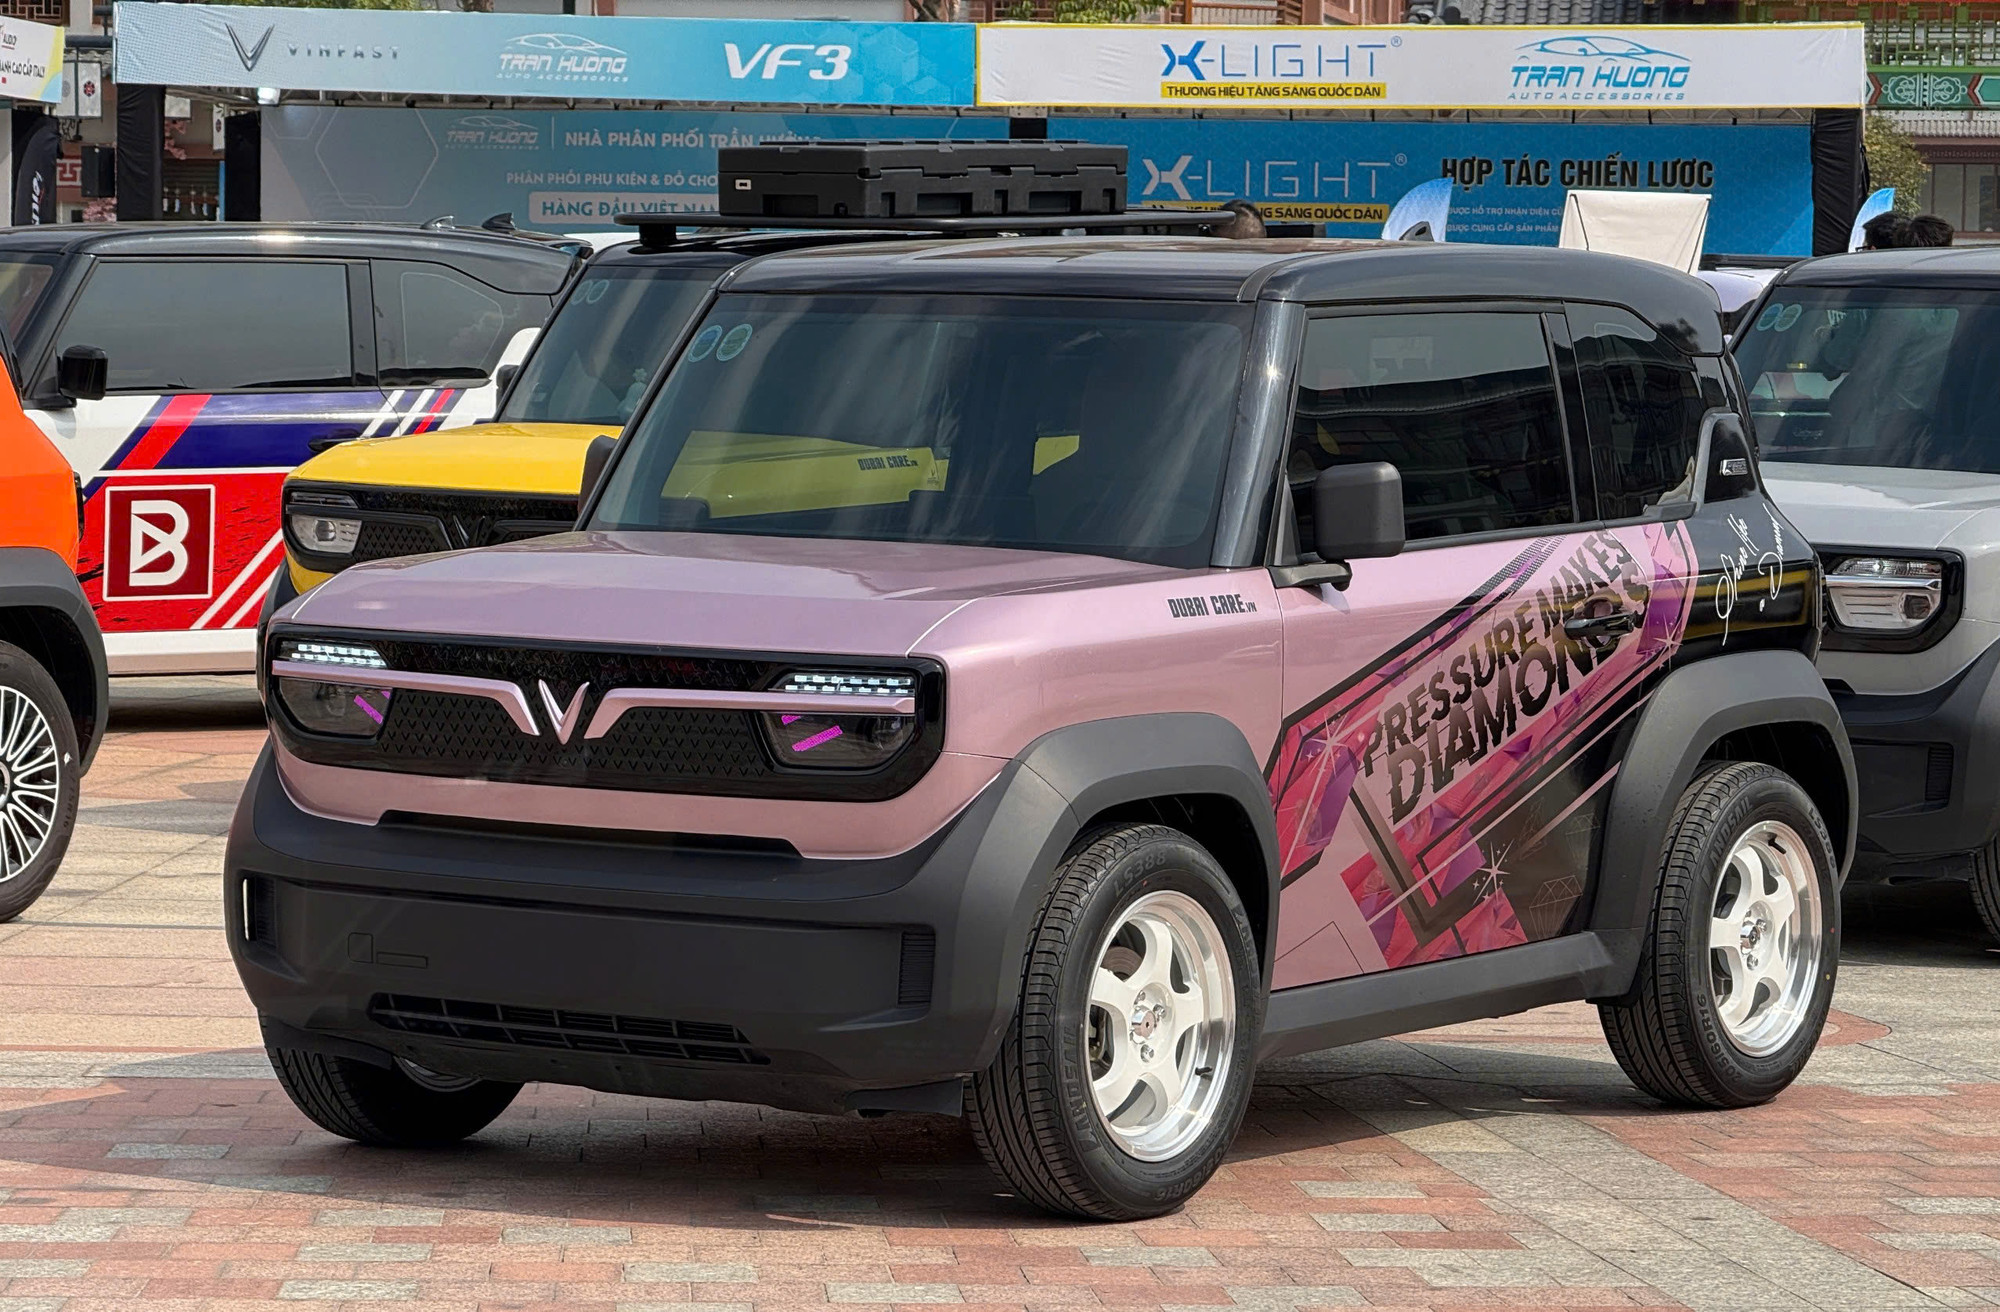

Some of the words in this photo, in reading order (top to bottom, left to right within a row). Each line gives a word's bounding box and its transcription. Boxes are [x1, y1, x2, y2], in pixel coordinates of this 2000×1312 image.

[288, 43, 399, 59] VINFAST
[0, 59, 11, 73] ANH
[496, 72, 531, 80] AUTO
[536, 74, 629, 83] ACCESSORIES
[1511, 65, 1586, 88] TRAN
[1591, 65, 1691, 89] HUONG
[1507, 92, 1554, 100] AUTO
[1558, 92, 1686, 101] ACCESSORIES
[564, 128, 602, 147] NHÀ
[607, 130, 657, 147] PHÂN
[661, 127, 704, 148] PHỐI
[708, 127, 753, 148] TRẦN
[507, 171, 543, 184] PHÂN
[547, 169, 581, 185] PHỐI
[584, 172, 613, 187] PHỤ
[651, 173, 661, 186] &
[1441, 155, 1493, 191] HỢP
[1502, 152, 1551, 187] TÁC
[1559, 151, 1639, 187] CHIẾN
[1646, 157, 1715, 193] LƯỢC
[542, 198, 593, 216] HÀNG
[1274, 203, 1312, 219] SÁNG
[1314, 204, 1352, 220] QUỐC
[1353, 205, 1383, 220] DÂN
[857, 456, 886, 471] DUBAI
[1167, 596, 1210, 618] DUBAI
[1362, 601, 1537, 777] PRESSURE
[1536, 530, 1633, 639] MAKES
